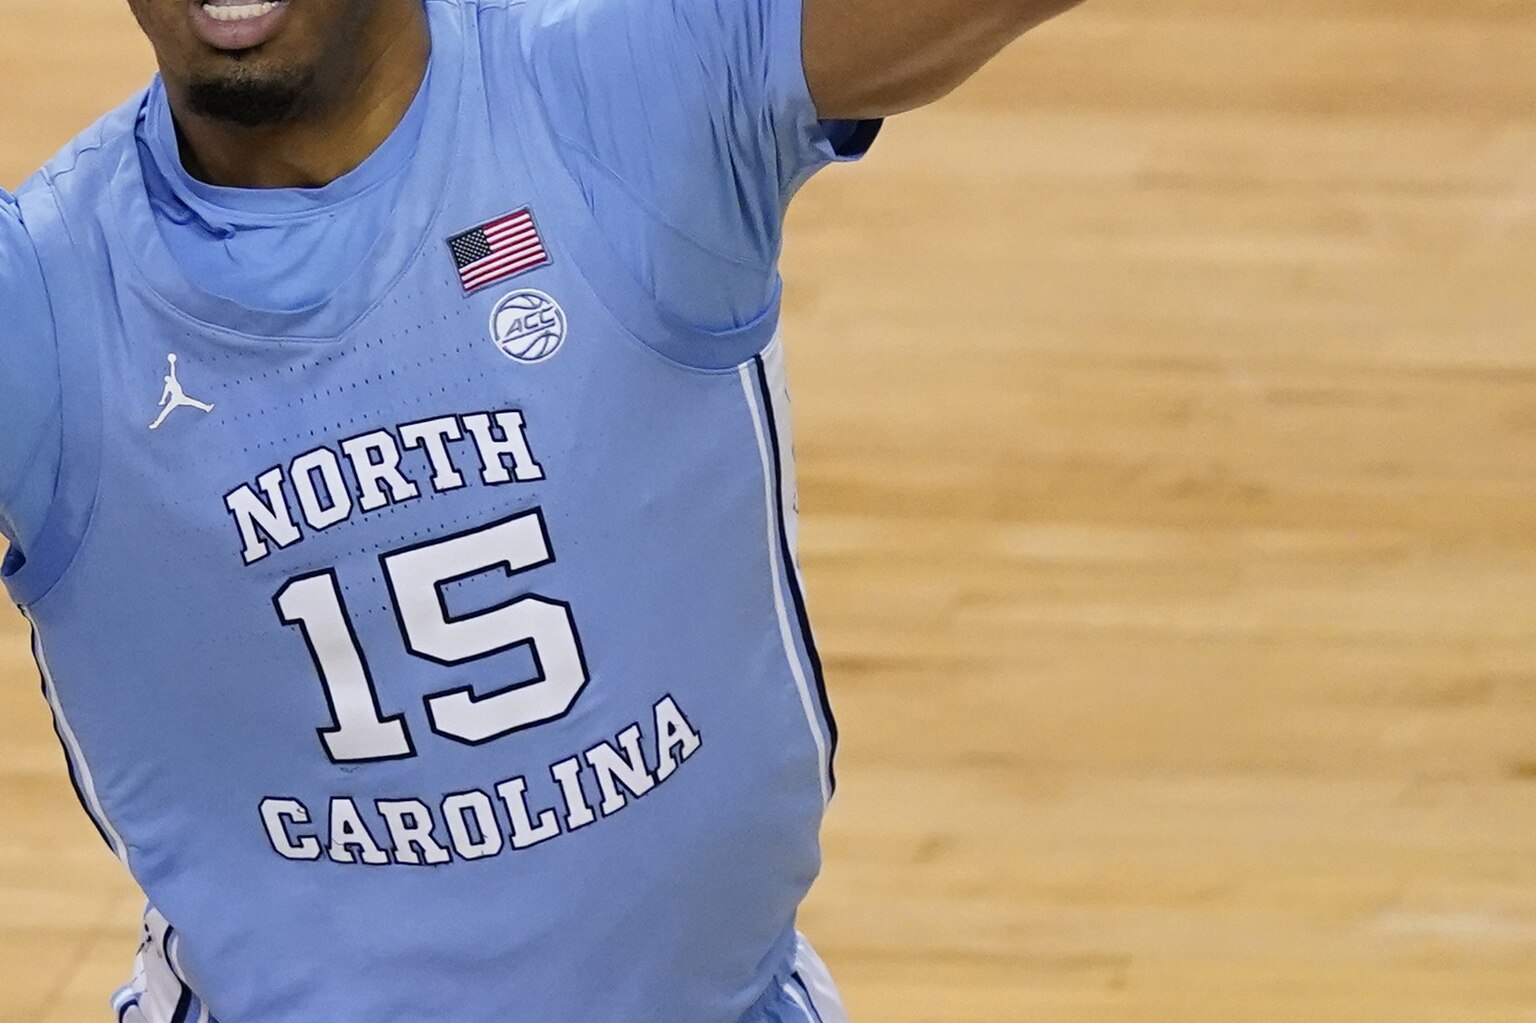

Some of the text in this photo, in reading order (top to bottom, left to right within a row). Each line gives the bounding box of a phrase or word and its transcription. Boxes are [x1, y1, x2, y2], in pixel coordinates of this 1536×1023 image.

[505, 306, 554, 337] ACC
[223, 409, 545, 565] NORTH
[271, 506, 590, 764] 15
[260, 693, 702, 867] CAROLINA
